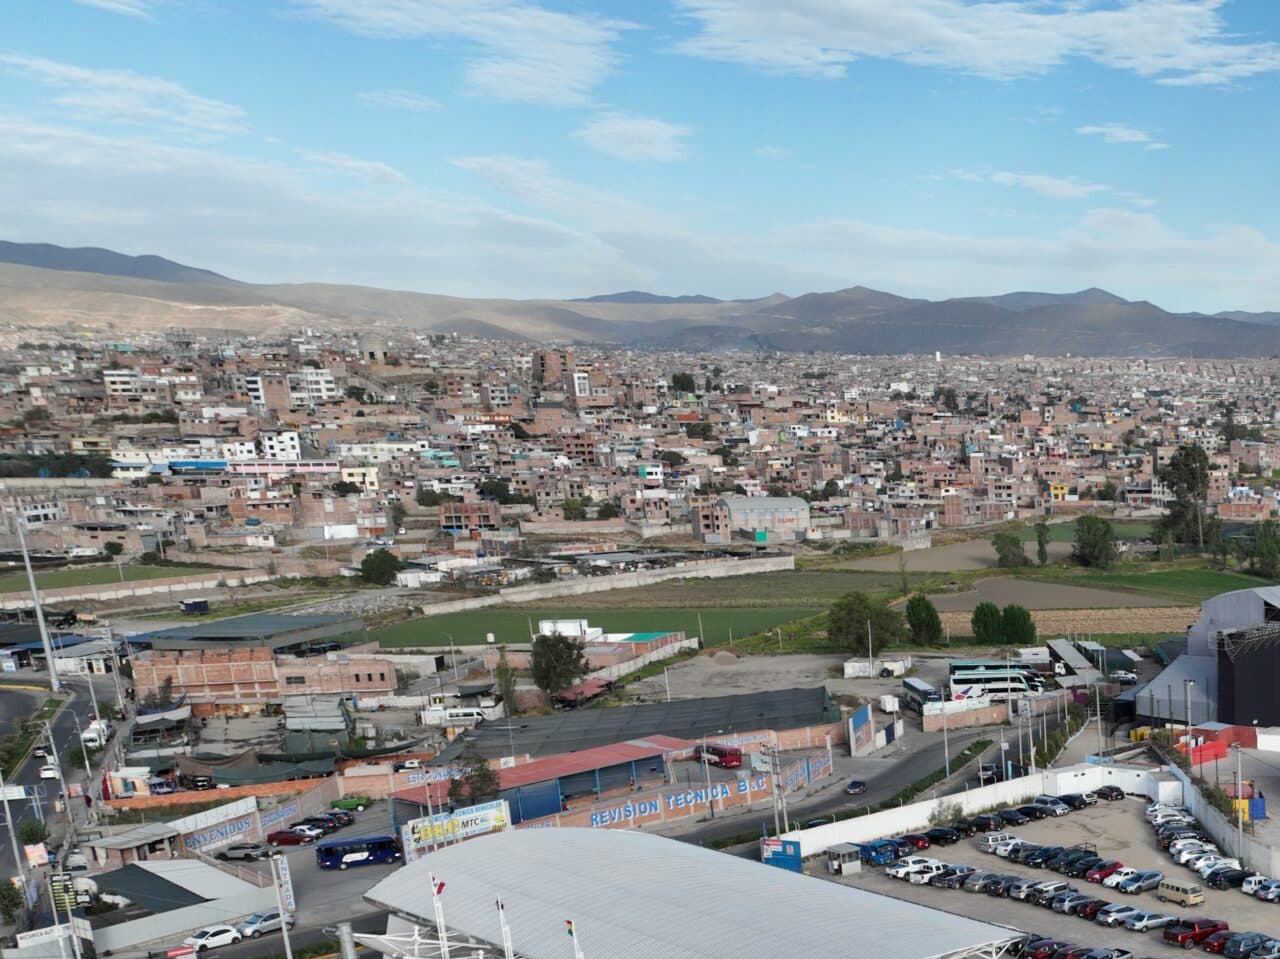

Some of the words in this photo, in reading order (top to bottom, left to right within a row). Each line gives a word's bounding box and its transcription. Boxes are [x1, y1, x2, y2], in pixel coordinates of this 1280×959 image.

[590, 800, 660, 827] REVISION
[666, 783, 731, 810] TECNICA
[461, 817, 480, 829] MTC
